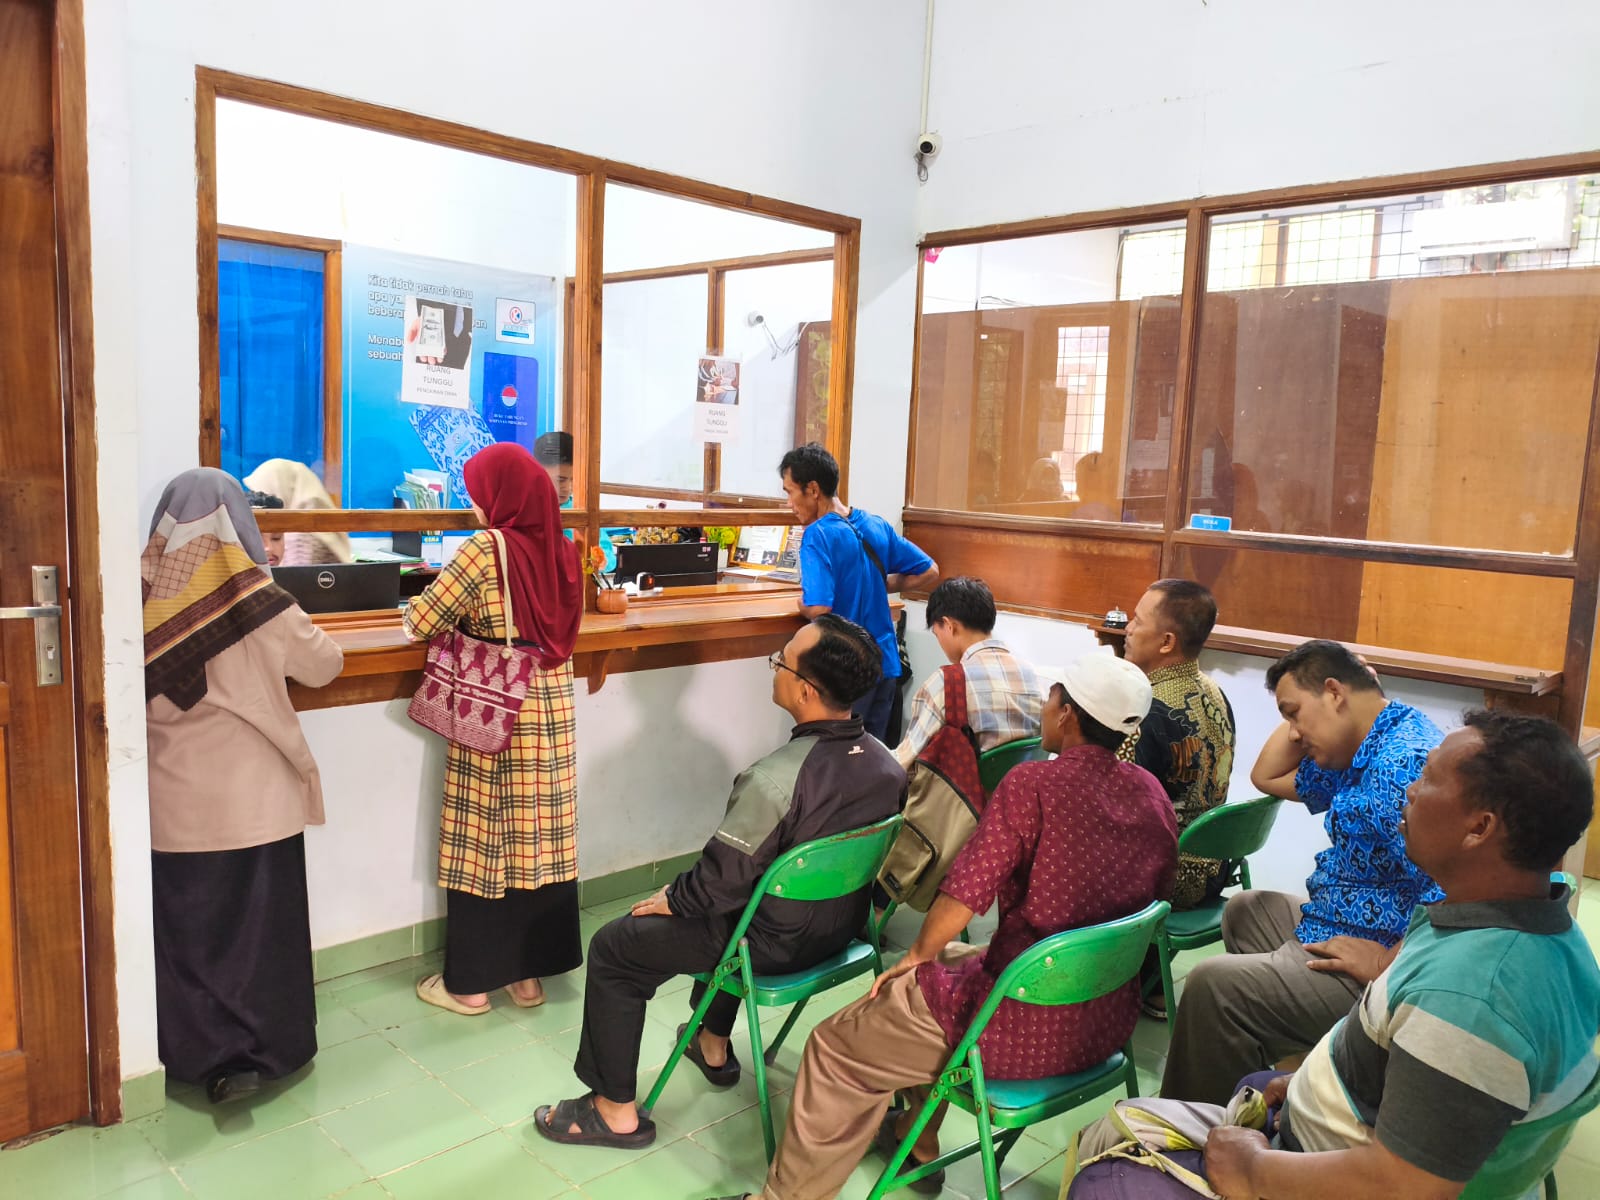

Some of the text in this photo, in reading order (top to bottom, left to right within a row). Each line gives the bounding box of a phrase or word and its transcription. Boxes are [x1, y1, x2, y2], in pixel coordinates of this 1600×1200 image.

[368, 290, 388, 304] apa
[426, 364, 451, 375] RUANG
[423, 375, 453, 387] TUNGGU
